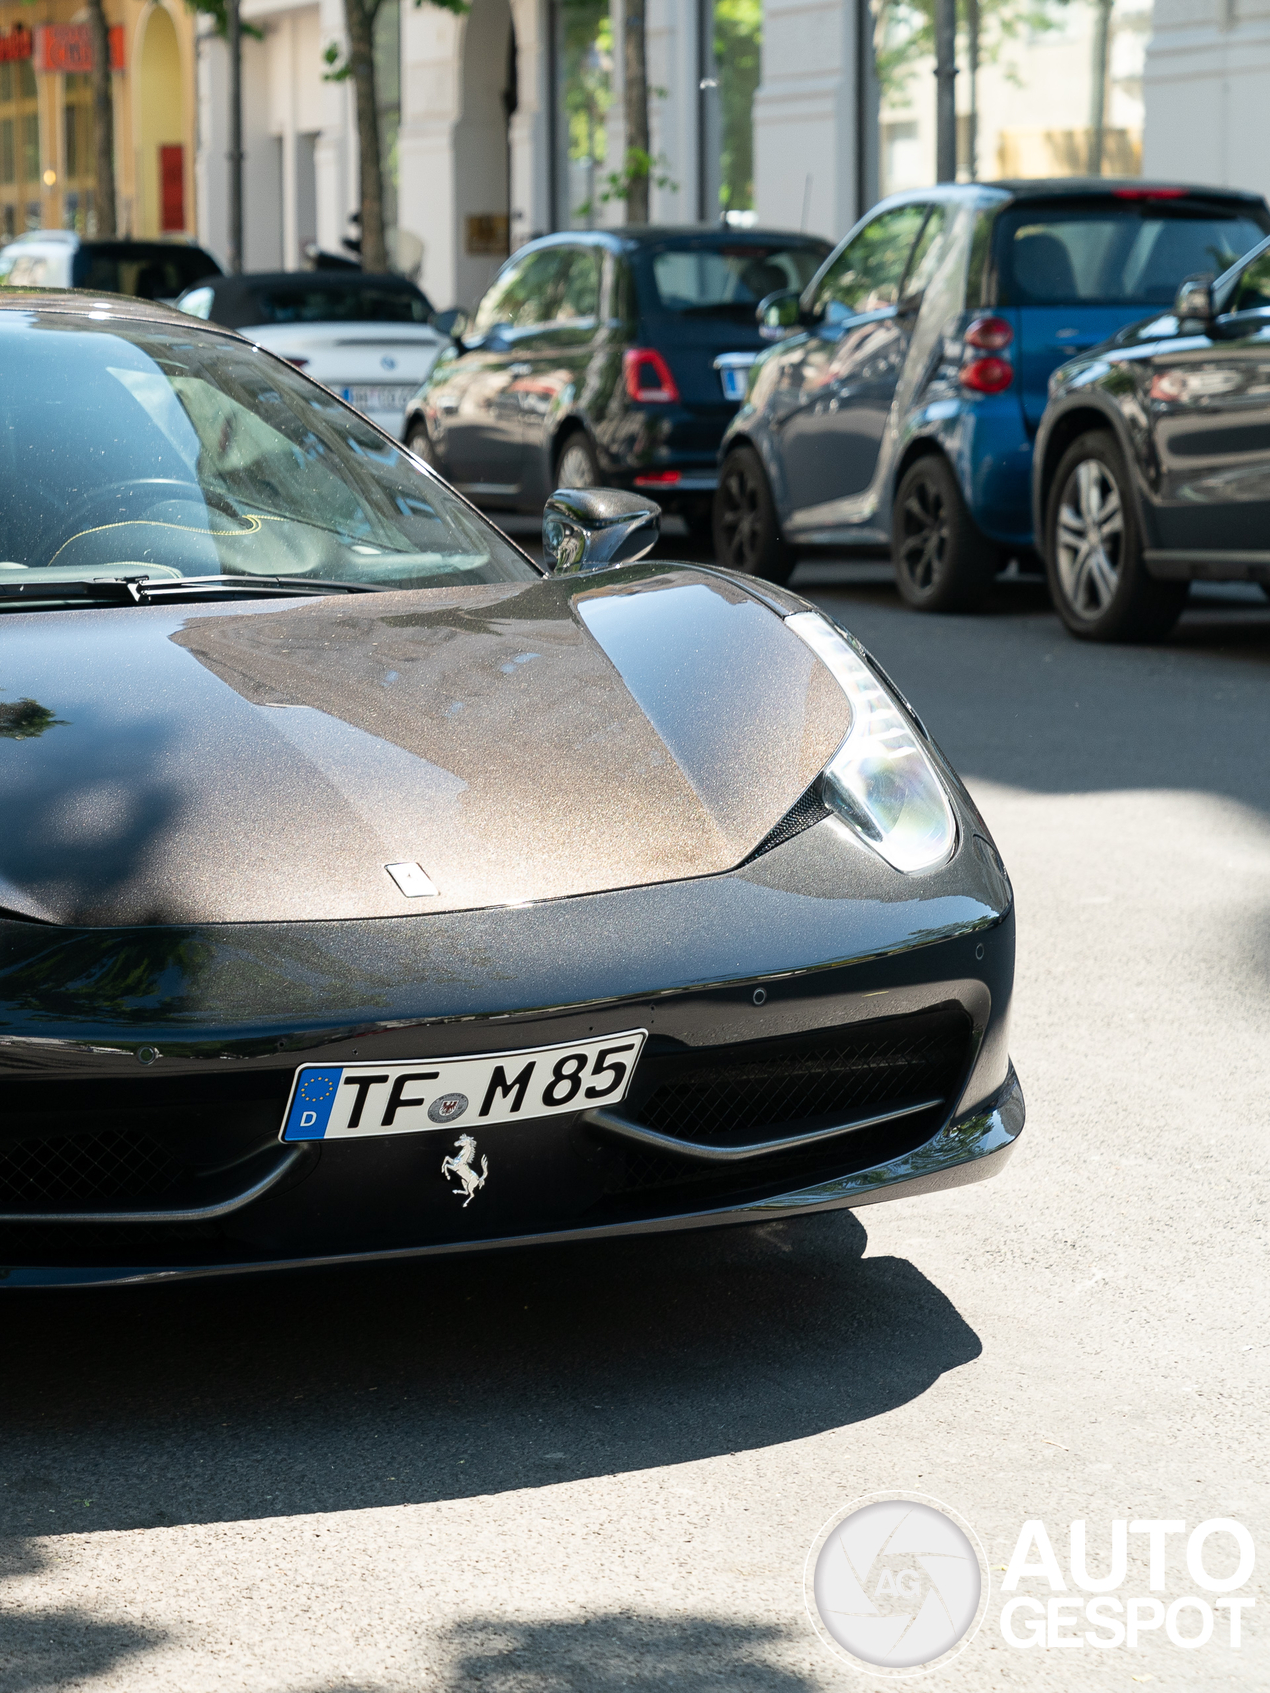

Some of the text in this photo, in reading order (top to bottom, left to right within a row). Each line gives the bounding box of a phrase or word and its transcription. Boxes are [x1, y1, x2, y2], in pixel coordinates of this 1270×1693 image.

[343, 1071, 440, 1129] TF
[478, 1061, 537, 1117] M
[541, 1043, 636, 1107] 85
[299, 1110, 318, 1128] D
